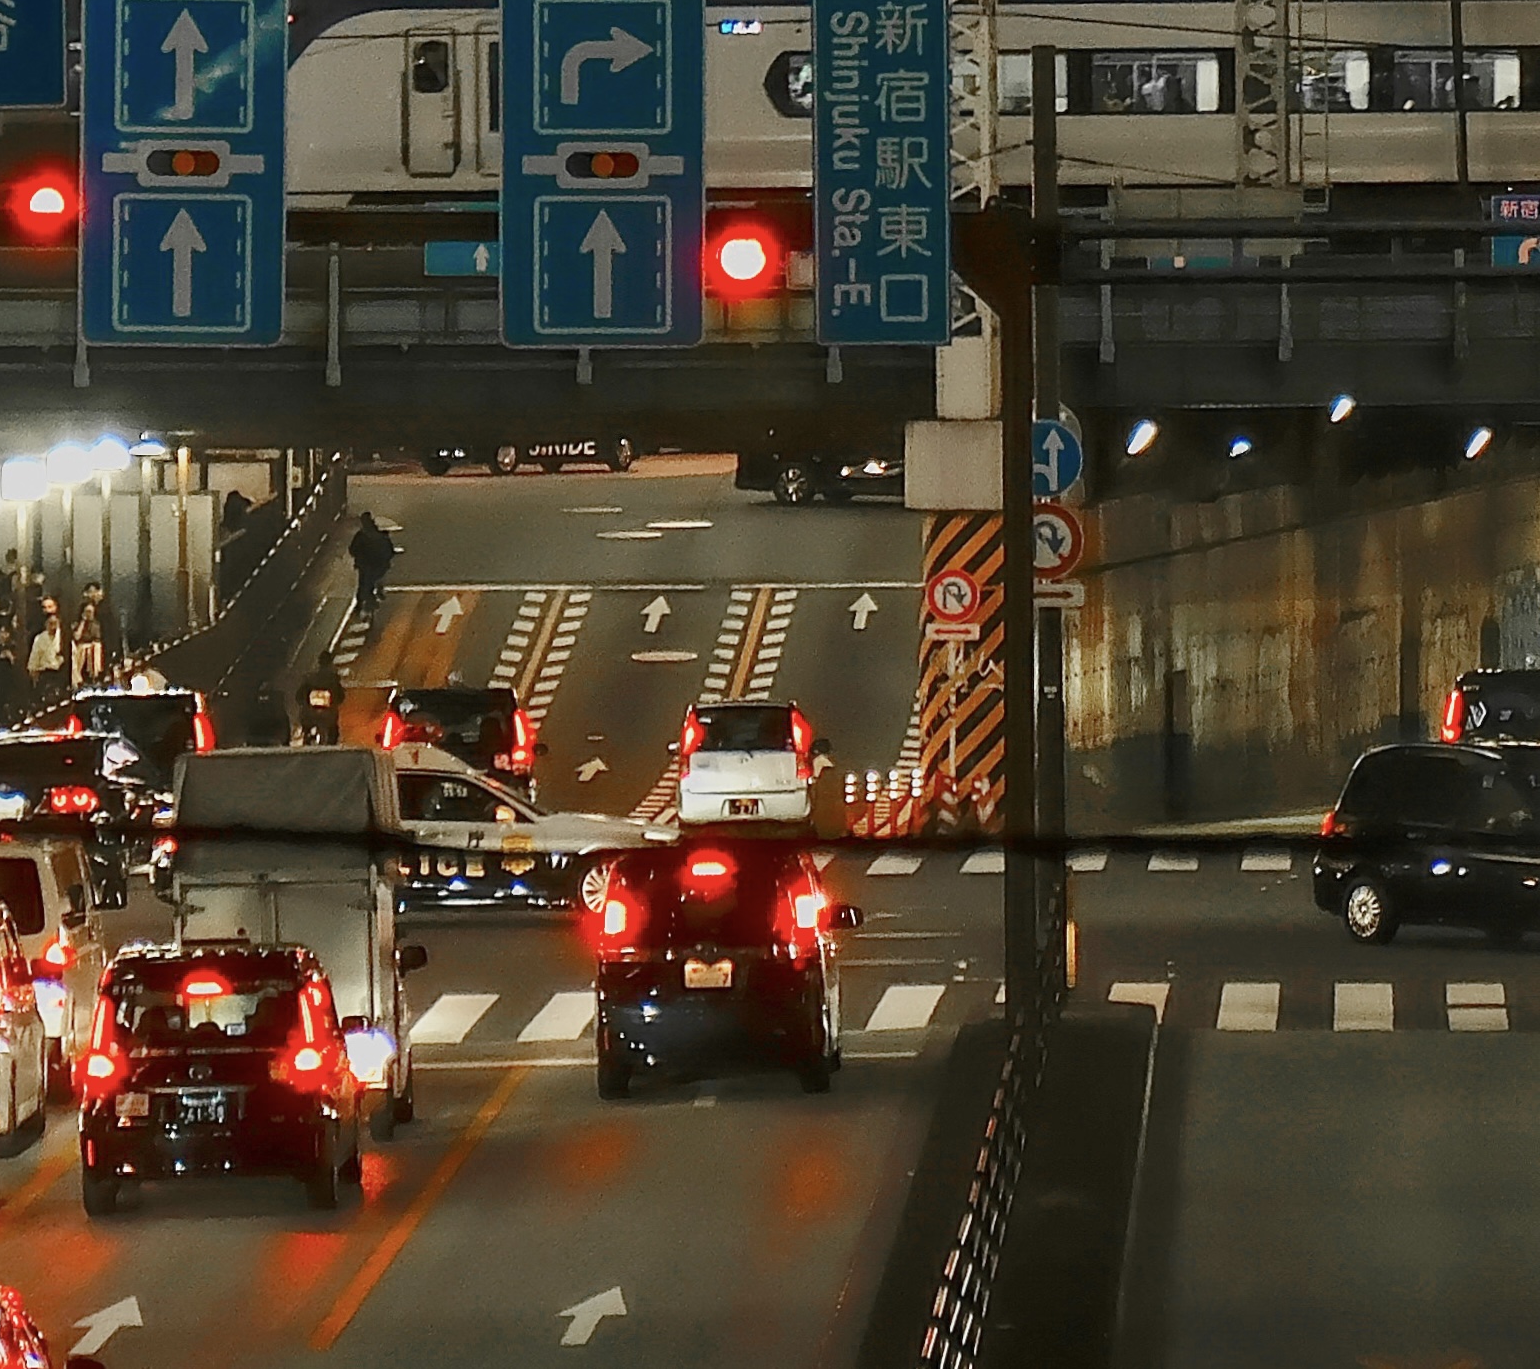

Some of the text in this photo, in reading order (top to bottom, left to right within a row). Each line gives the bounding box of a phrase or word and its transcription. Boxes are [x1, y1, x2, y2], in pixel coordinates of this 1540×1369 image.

[828, 9, 872, 179] Shinjuku
[873, 0, 933, 325] 新宿駅東口
